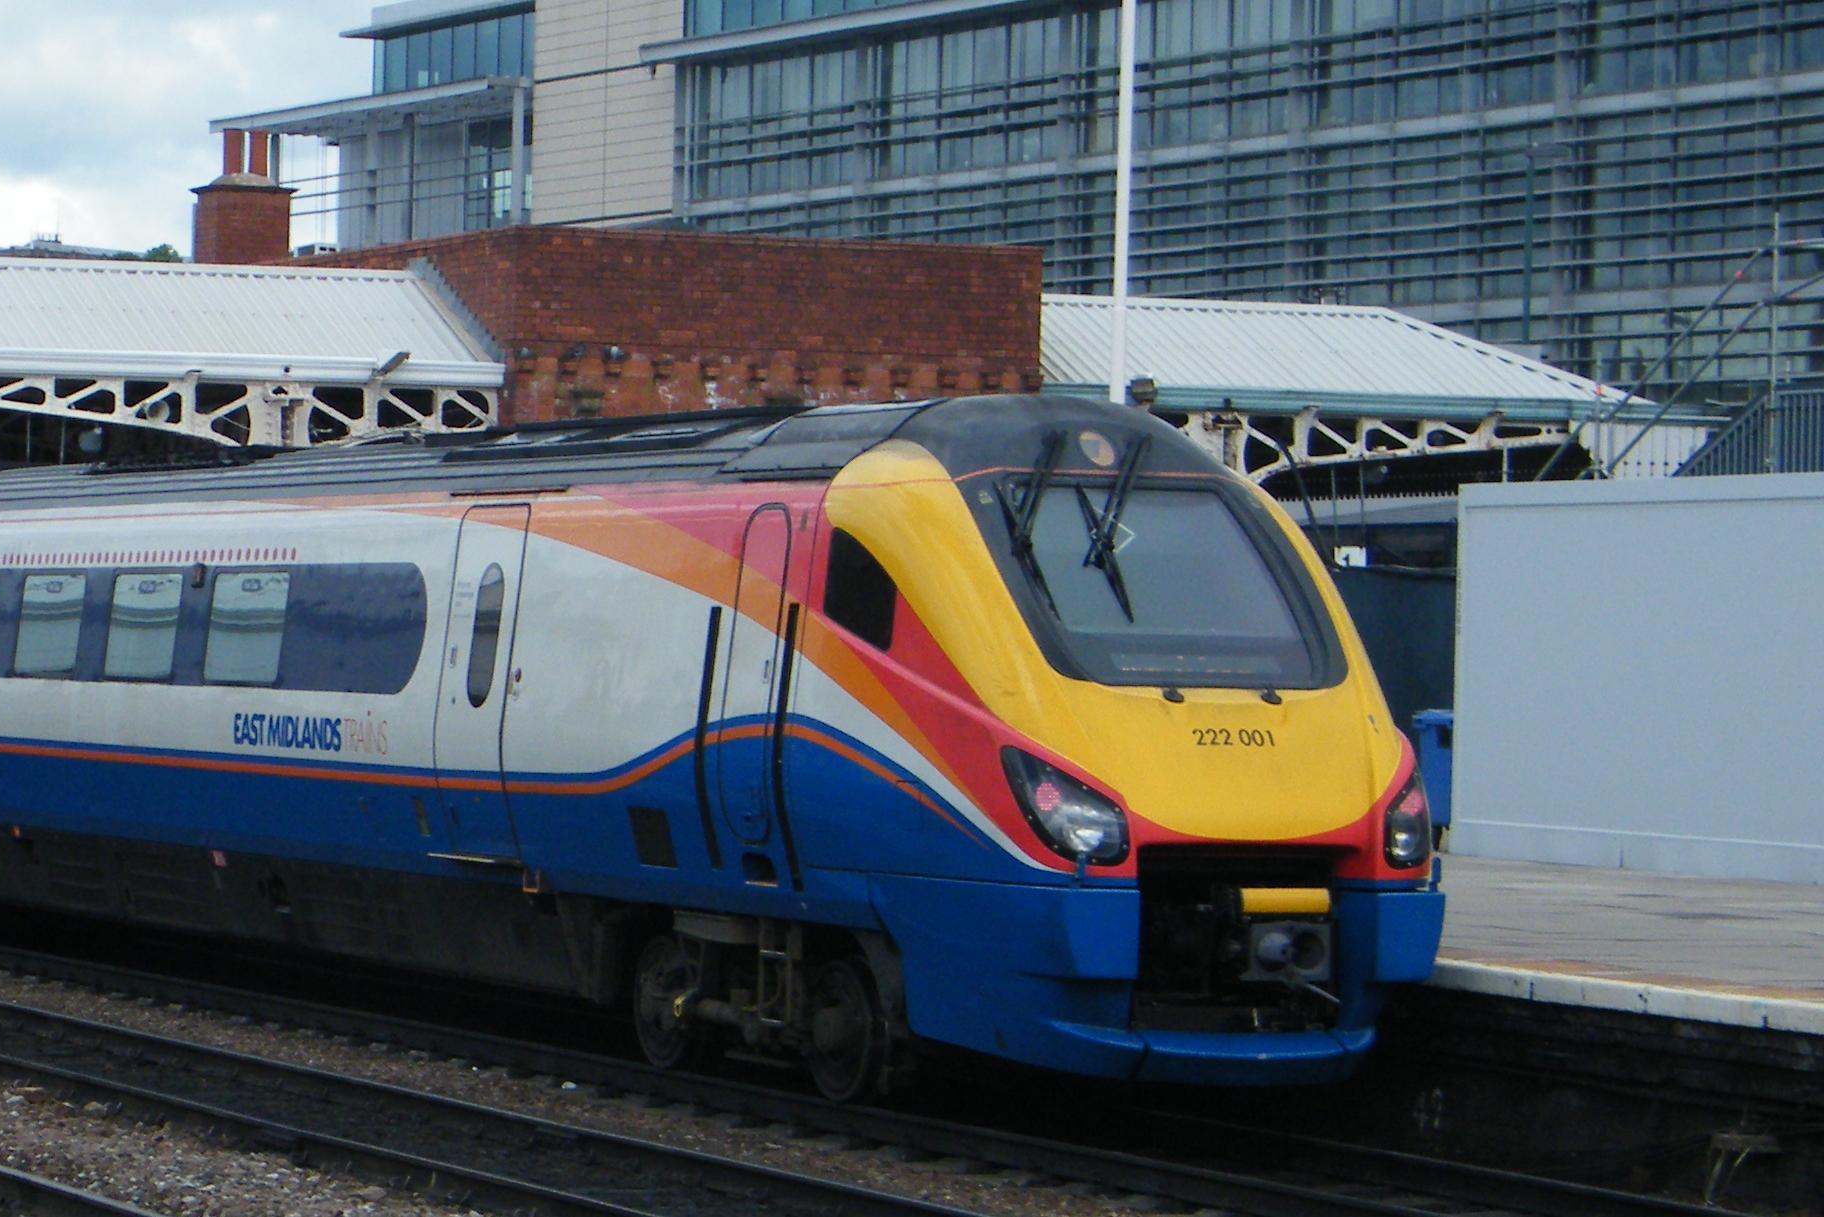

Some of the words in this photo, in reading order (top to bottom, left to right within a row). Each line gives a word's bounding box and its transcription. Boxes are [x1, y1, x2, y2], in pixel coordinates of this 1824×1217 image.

[234, 713, 266, 746] EAST
[267, 715, 342, 752] MIDLANDS
[1192, 728, 1233, 746] 222
[1238, 728, 1275, 747] 001
